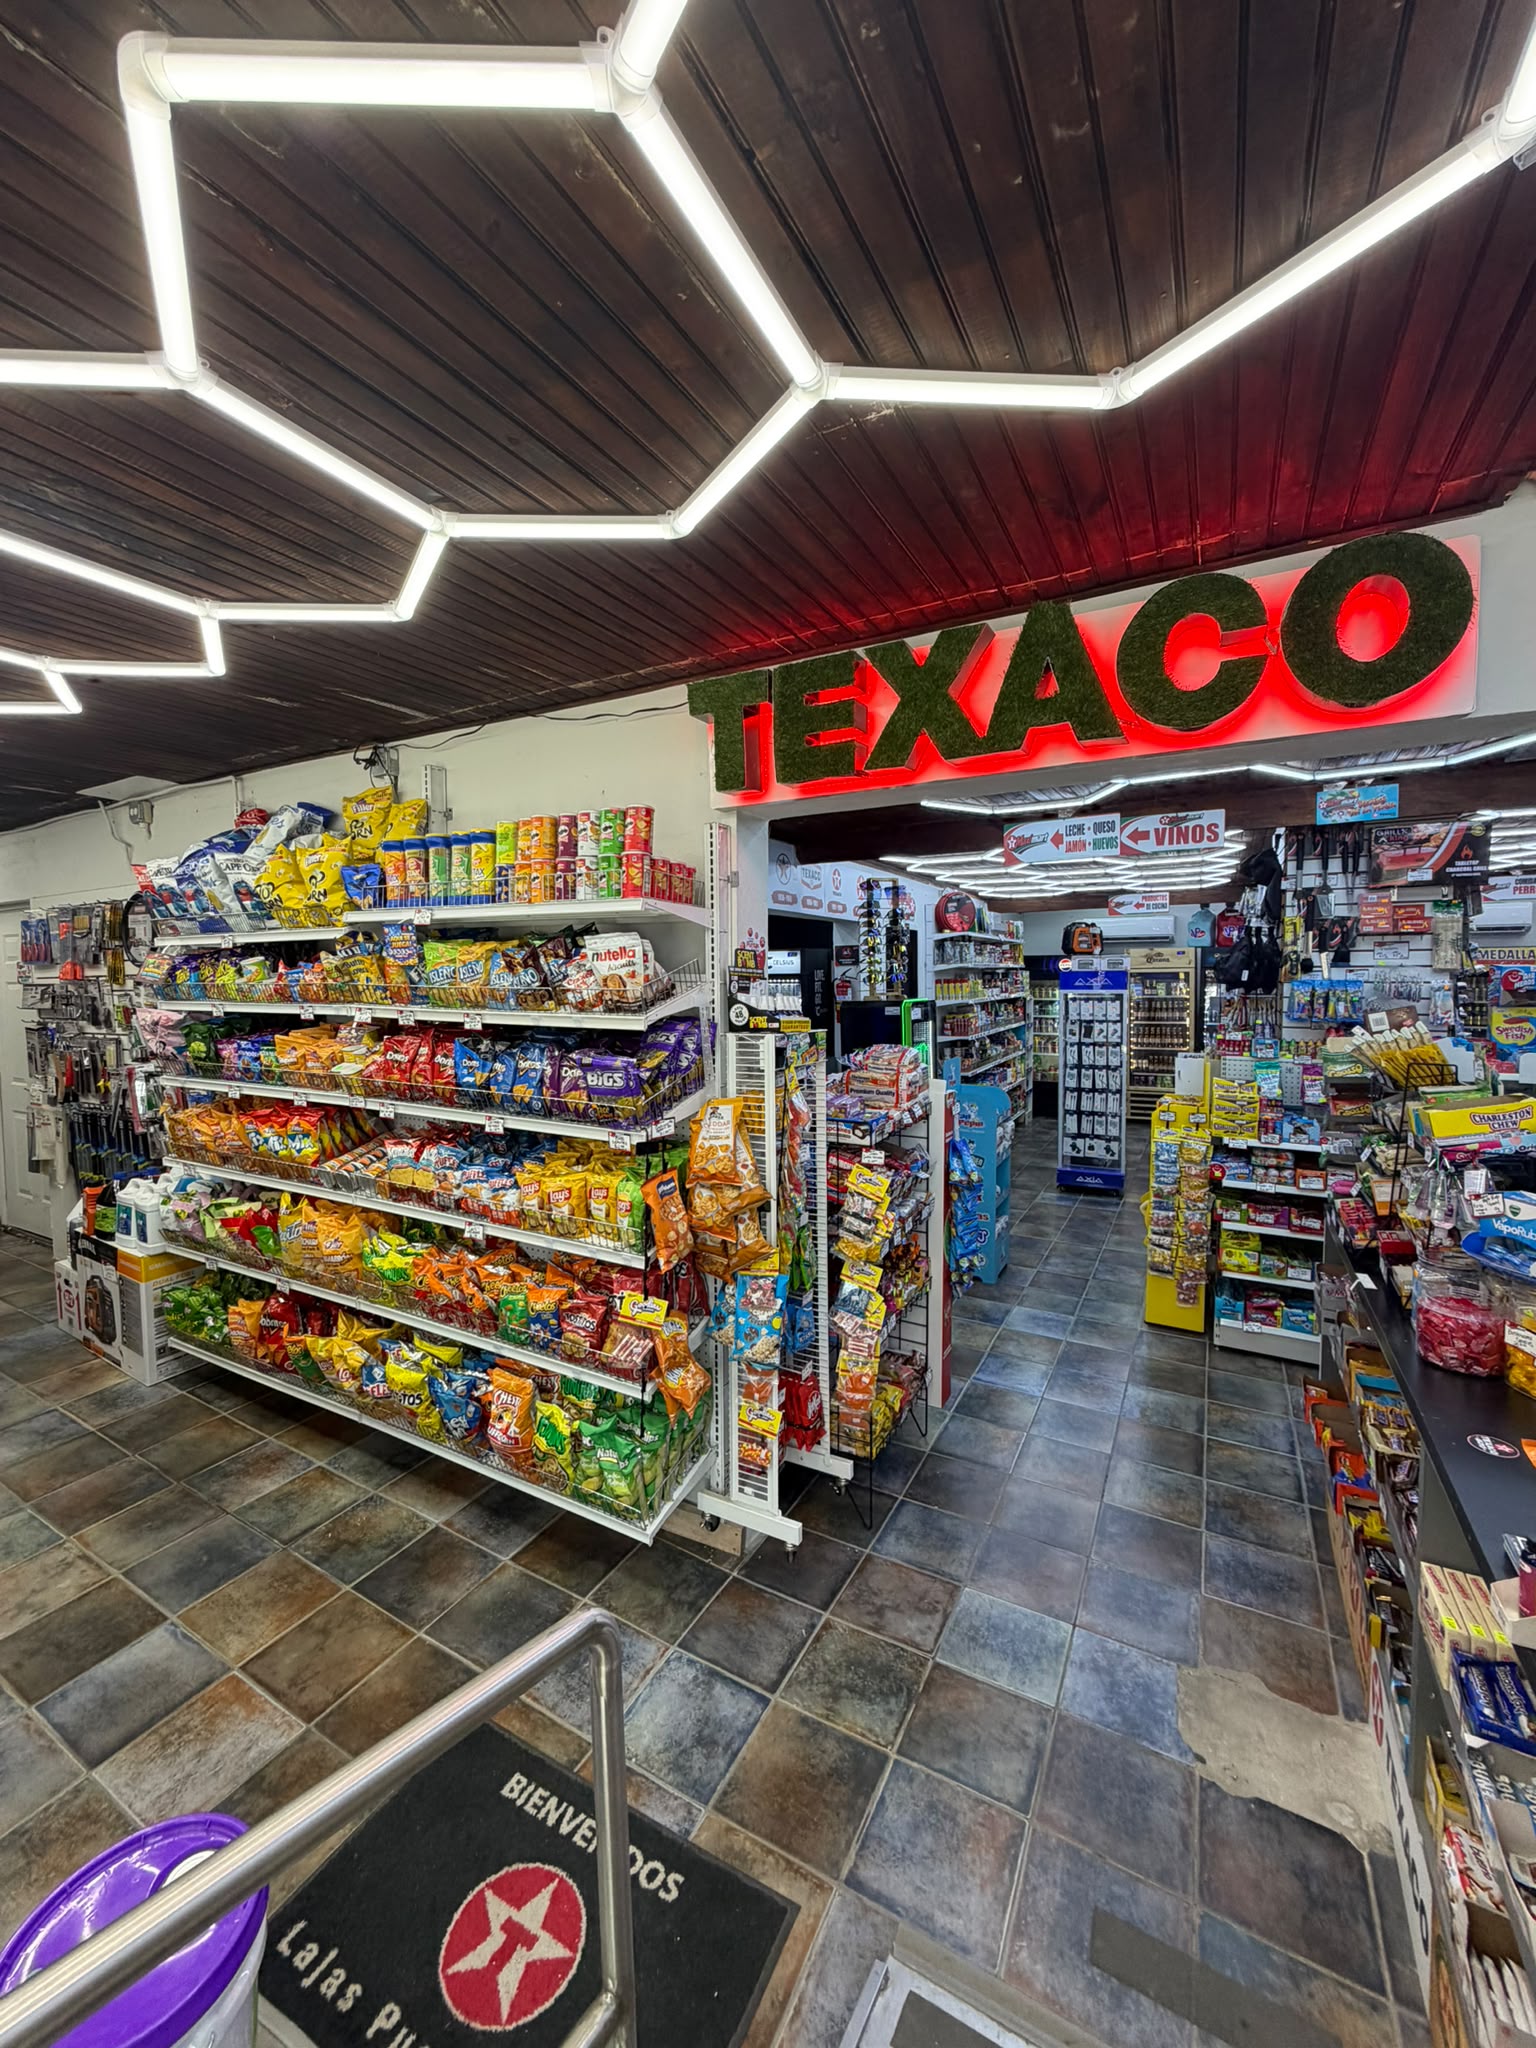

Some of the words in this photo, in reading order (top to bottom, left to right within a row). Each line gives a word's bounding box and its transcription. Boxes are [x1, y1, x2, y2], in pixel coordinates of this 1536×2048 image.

[688, 532, 1475, 793] TEXACO
[1065, 824, 1086, 837] LECHE
[1092, 819, 1116, 834] QUESO
[1153, 824, 1220, 846] VINOS
[1065, 838, 1087, 854] JAMÓN
[1092, 836, 1119, 851] HUEVOS
[801, 867, 821, 881] TEXACO
[592, 946, 636, 963] nutella
[1479, 949, 1536, 961] MEDALLA
[734, 1011, 744, 1019] 48
[1495, 1024, 1534, 1036] Swedish
[1503, 1031, 1527, 1042] Fish
[850, 1087, 875, 1095] Premium
[875, 1089, 896, 1098] Quality
[1472, 1107, 1532, 1124] CHARLESTON
[1491, 1120, 1519, 1130] CHEW
[1076, 1176, 1104, 1184] AXIA
[549, 1187, 571, 1203] Lay's
[590, 1187, 609, 1200] Lay's
[500, 1284, 528, 1297] Cheetos
[528, 1302, 557, 1317] Cheetos
[500, 1771, 686, 1903] BIENVEDOS
[276, 1920, 363, 2013] Lajas
